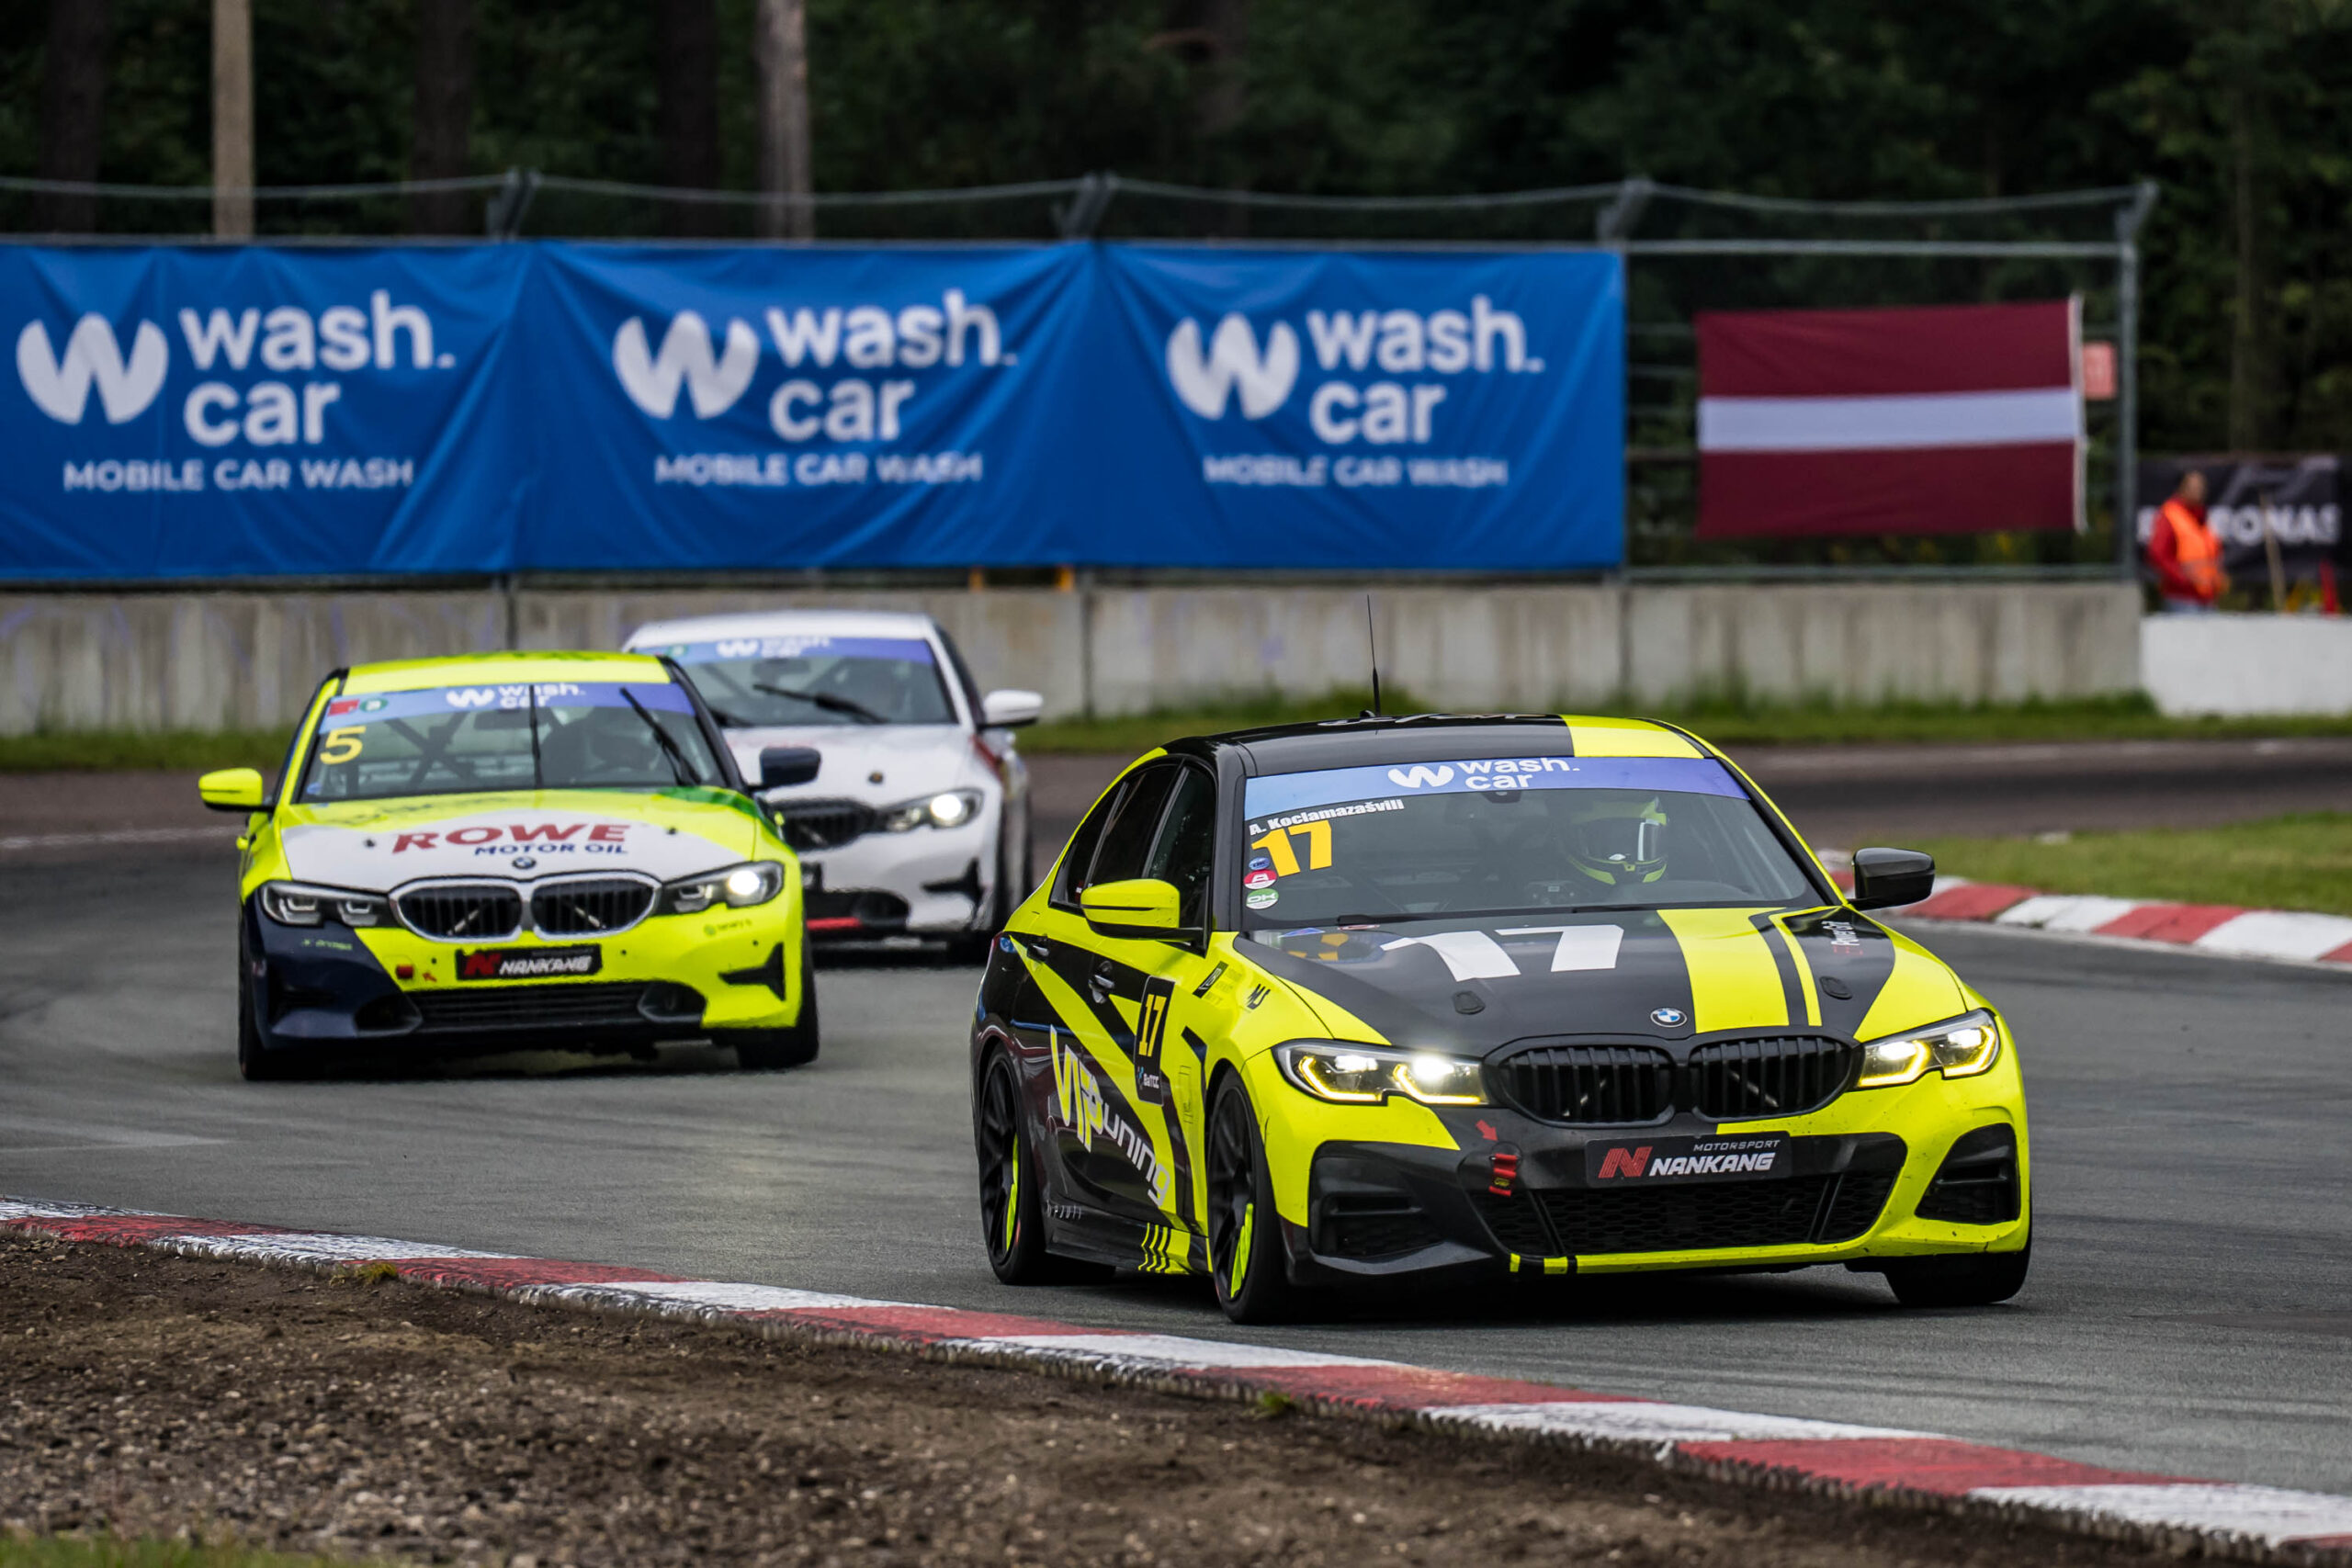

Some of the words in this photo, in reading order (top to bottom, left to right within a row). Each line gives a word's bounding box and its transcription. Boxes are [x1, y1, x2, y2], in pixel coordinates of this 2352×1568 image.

[184, 382, 341, 446] car
[769, 378, 915, 442] car
[1309, 381, 1447, 444] car
[63, 459, 204, 491] MOBILE
[213, 459, 291, 490] CAR
[300, 457, 413, 489] WASH
[655, 454, 788, 485] MOBILE
[795, 454, 868, 484] CAR
[876, 452, 982, 483] WASH
[1203, 456, 1329, 487] MOBILE
[1334, 456, 1402, 487] CAR
[1407, 457, 1509, 488] WASH
[320, 726, 367, 764] 5
[1464, 773, 1532, 790] car
[392, 824, 632, 854] ROWE
[1249, 823, 1267, 836] A.
[474, 844, 575, 855] MOTOR
[584, 842, 628, 853] OIL
[1250, 819, 1332, 877] 17
[499, 954, 593, 976] NANKANG
[1380, 924, 1624, 982] 17
[1138, 994, 1167, 1056] 17
[1693, 1140, 1781, 1152] MOTORSPORT
[1649, 1152, 1776, 1177] NANKANG
